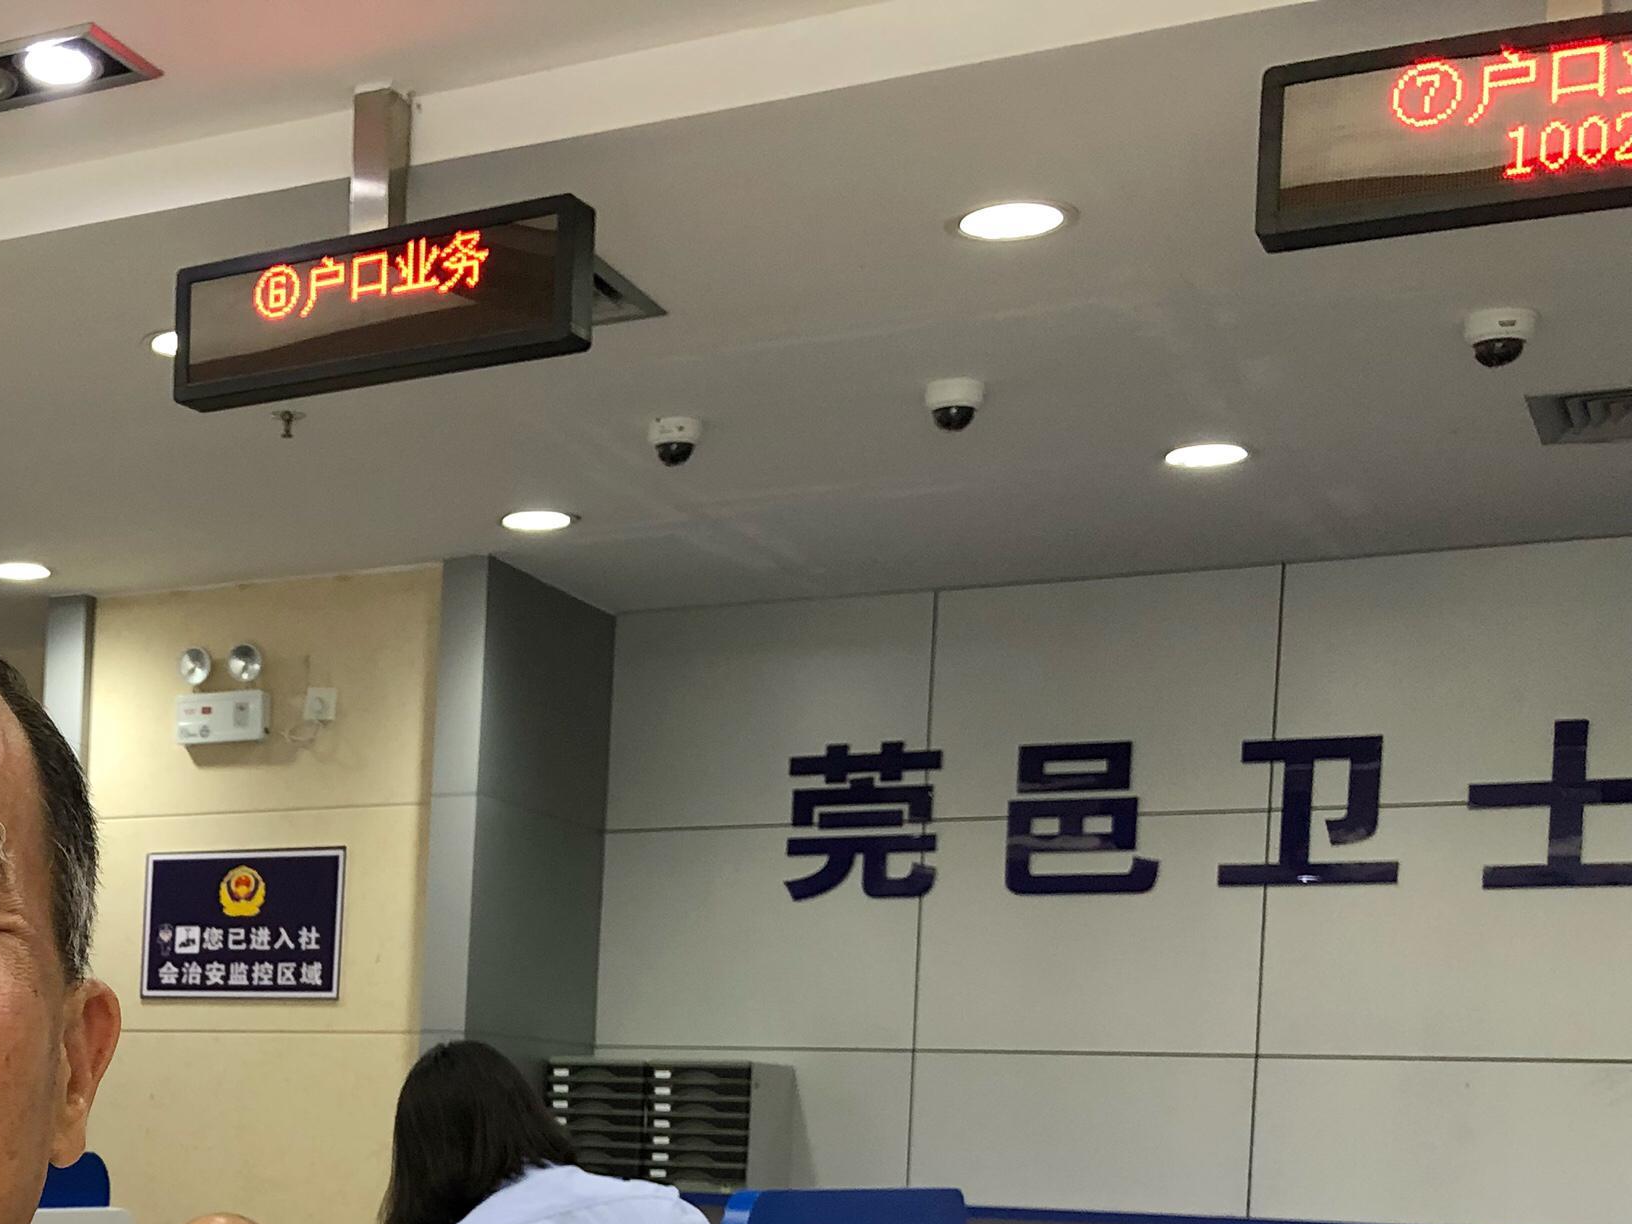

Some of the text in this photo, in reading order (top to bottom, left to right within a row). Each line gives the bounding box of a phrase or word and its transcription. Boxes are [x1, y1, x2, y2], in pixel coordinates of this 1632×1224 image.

[783, 719, 1632, 901] 莞邑卫士
[203, 926, 321, 951] 您已进入社
[158, 961, 323, 986] 会治安监控区域
